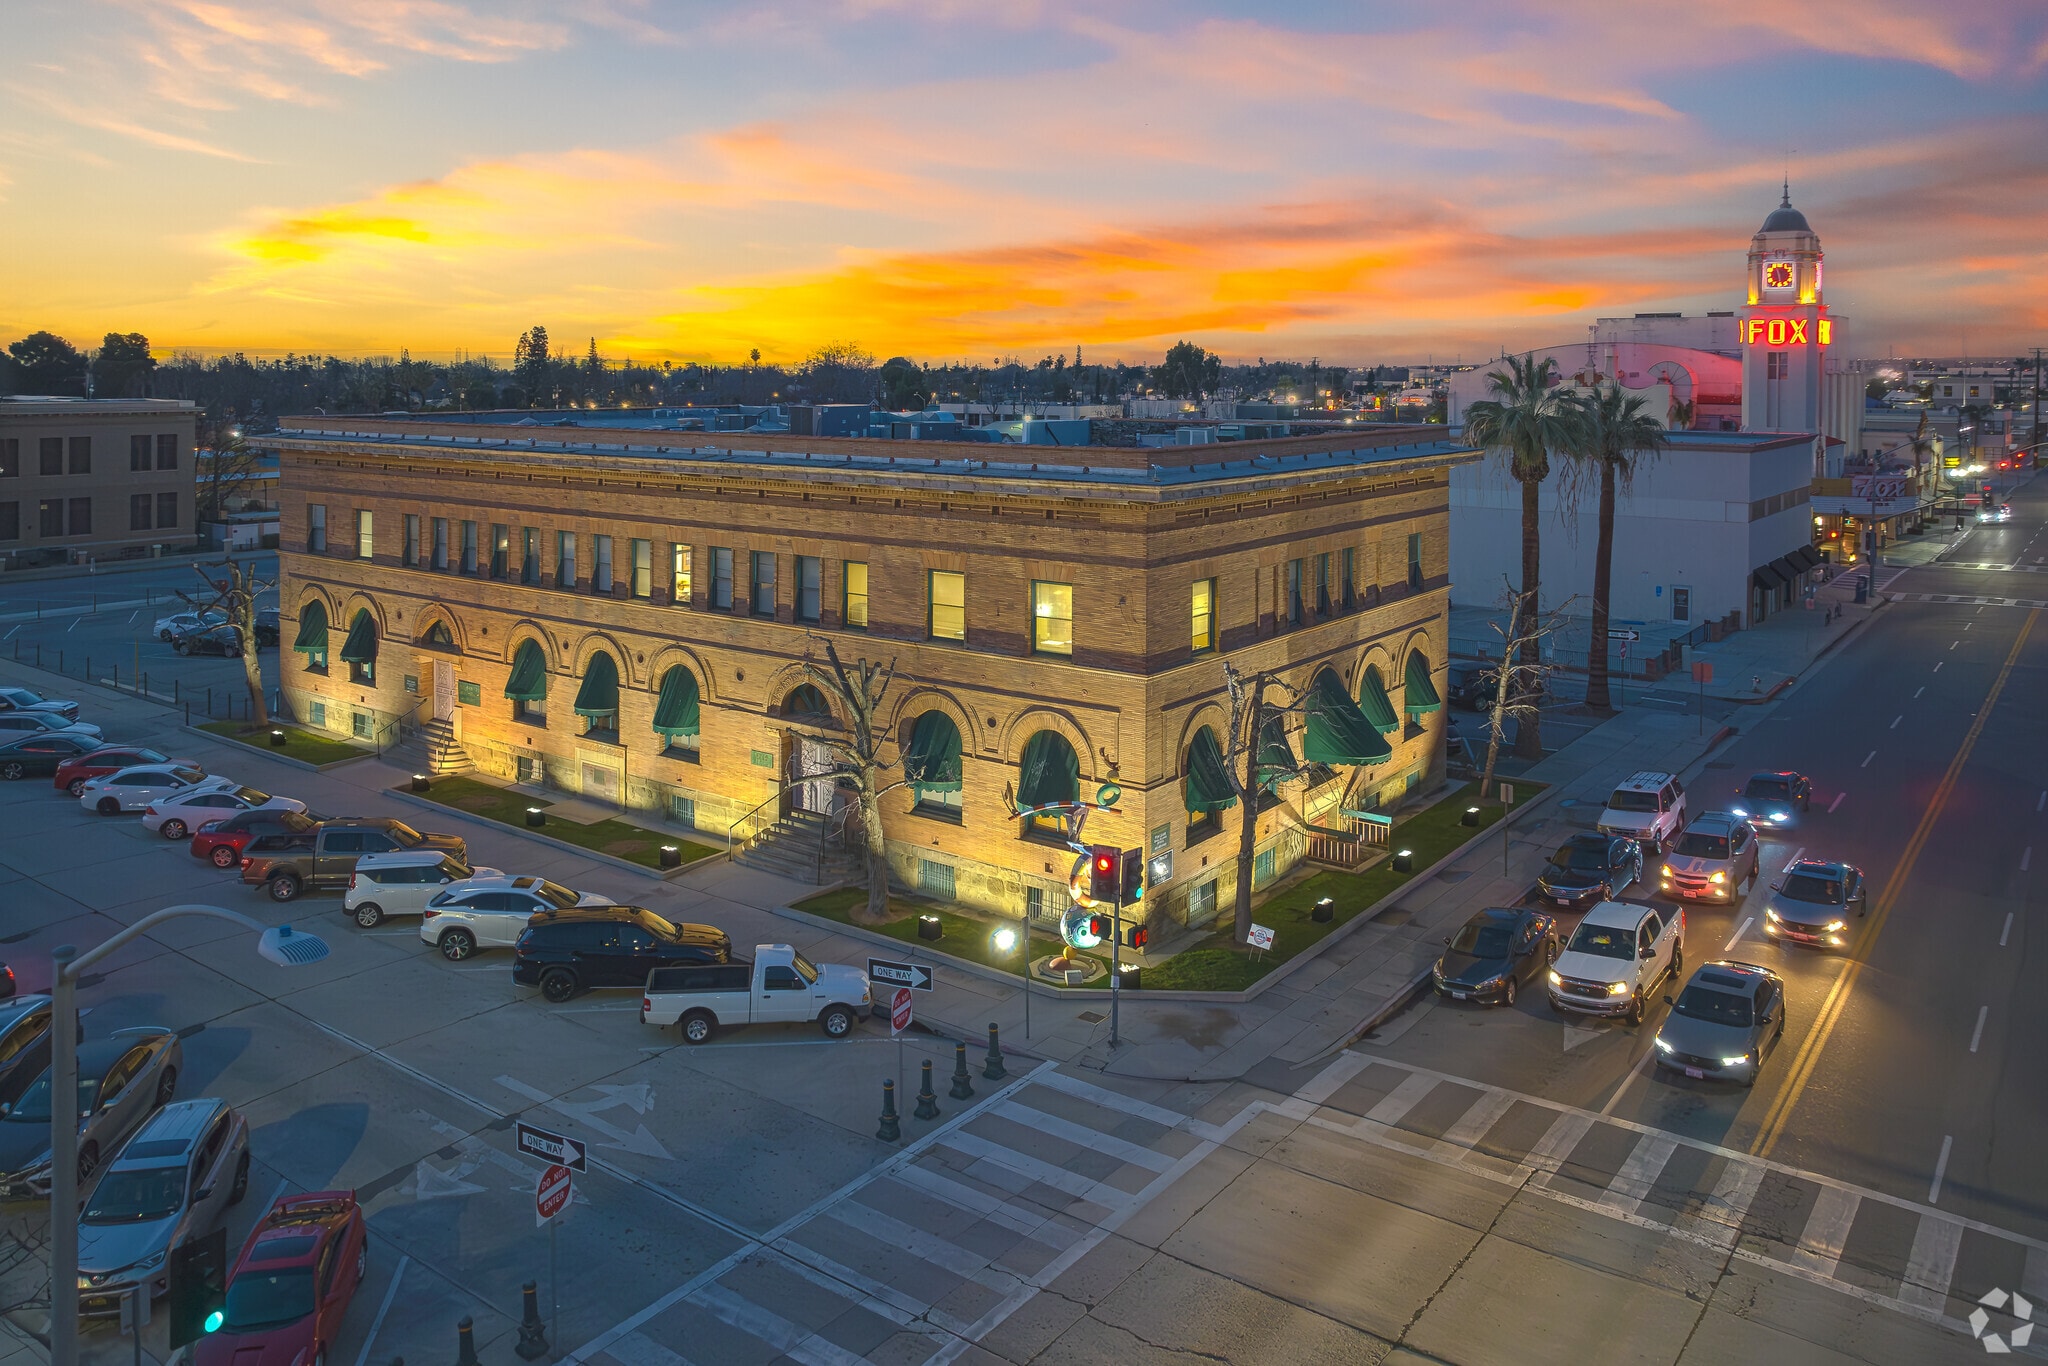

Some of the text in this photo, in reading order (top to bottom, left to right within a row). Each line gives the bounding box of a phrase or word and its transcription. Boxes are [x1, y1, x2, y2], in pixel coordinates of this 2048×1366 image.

[1748, 319, 1808, 344] FOX
[878, 967, 912, 980] ONE WAY
[527, 1135, 564, 1155] ONE WAY
[541, 1167, 567, 1191] DO NOT
[543, 1191, 565, 1211] ENTER
